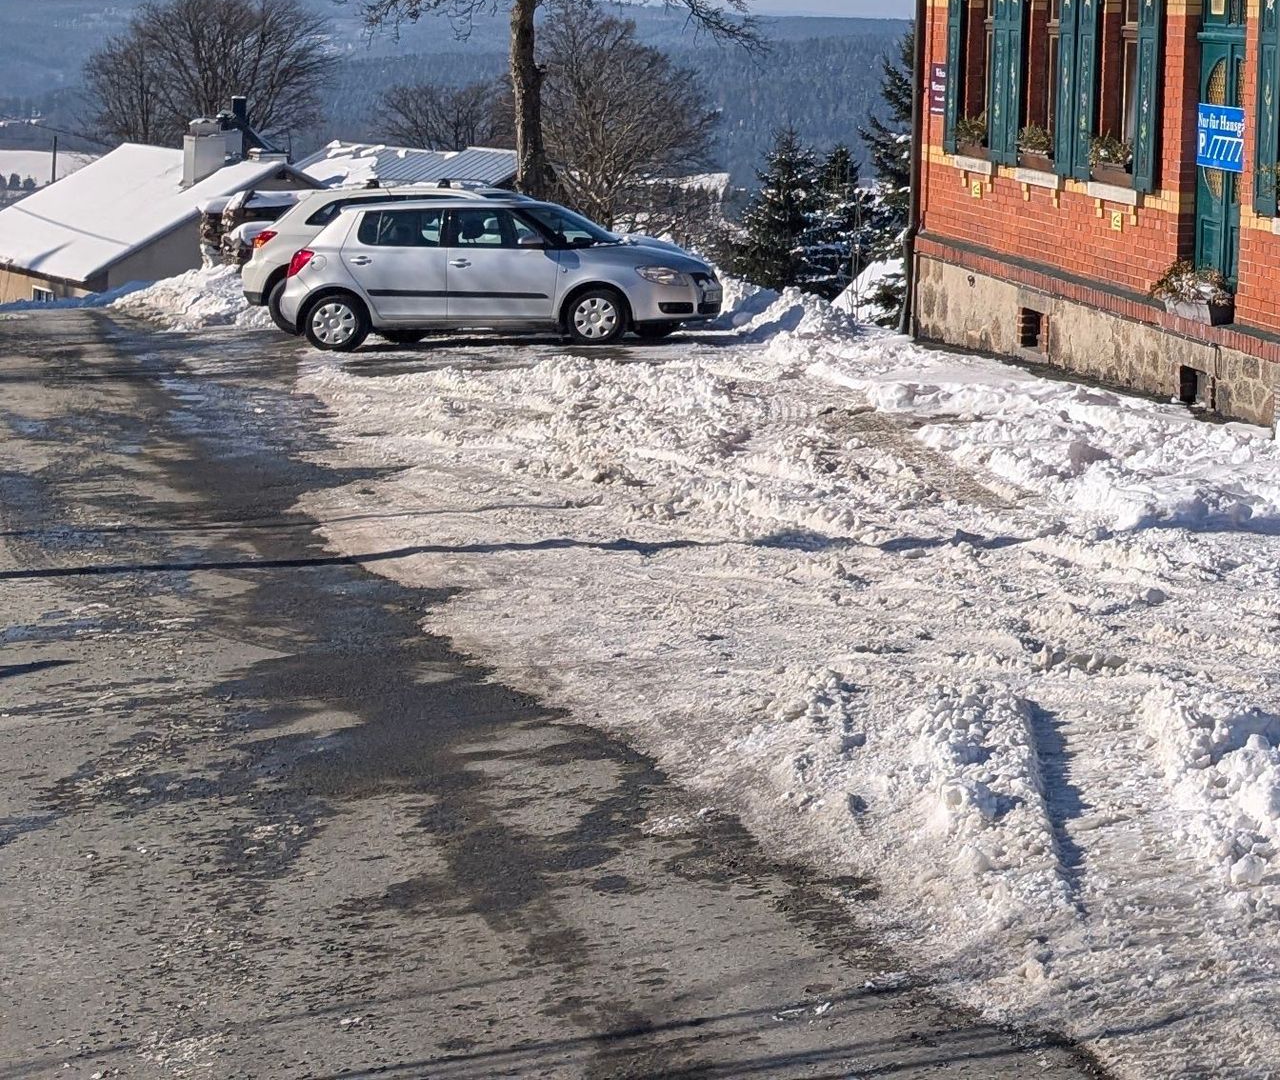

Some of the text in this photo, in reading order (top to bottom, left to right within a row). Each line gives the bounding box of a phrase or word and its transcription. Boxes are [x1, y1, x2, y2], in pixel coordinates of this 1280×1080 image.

[1198, 112, 1209, 128] Nur
[1210, 113, 1219, 129] für
[1199, 132, 1206, 154] P
